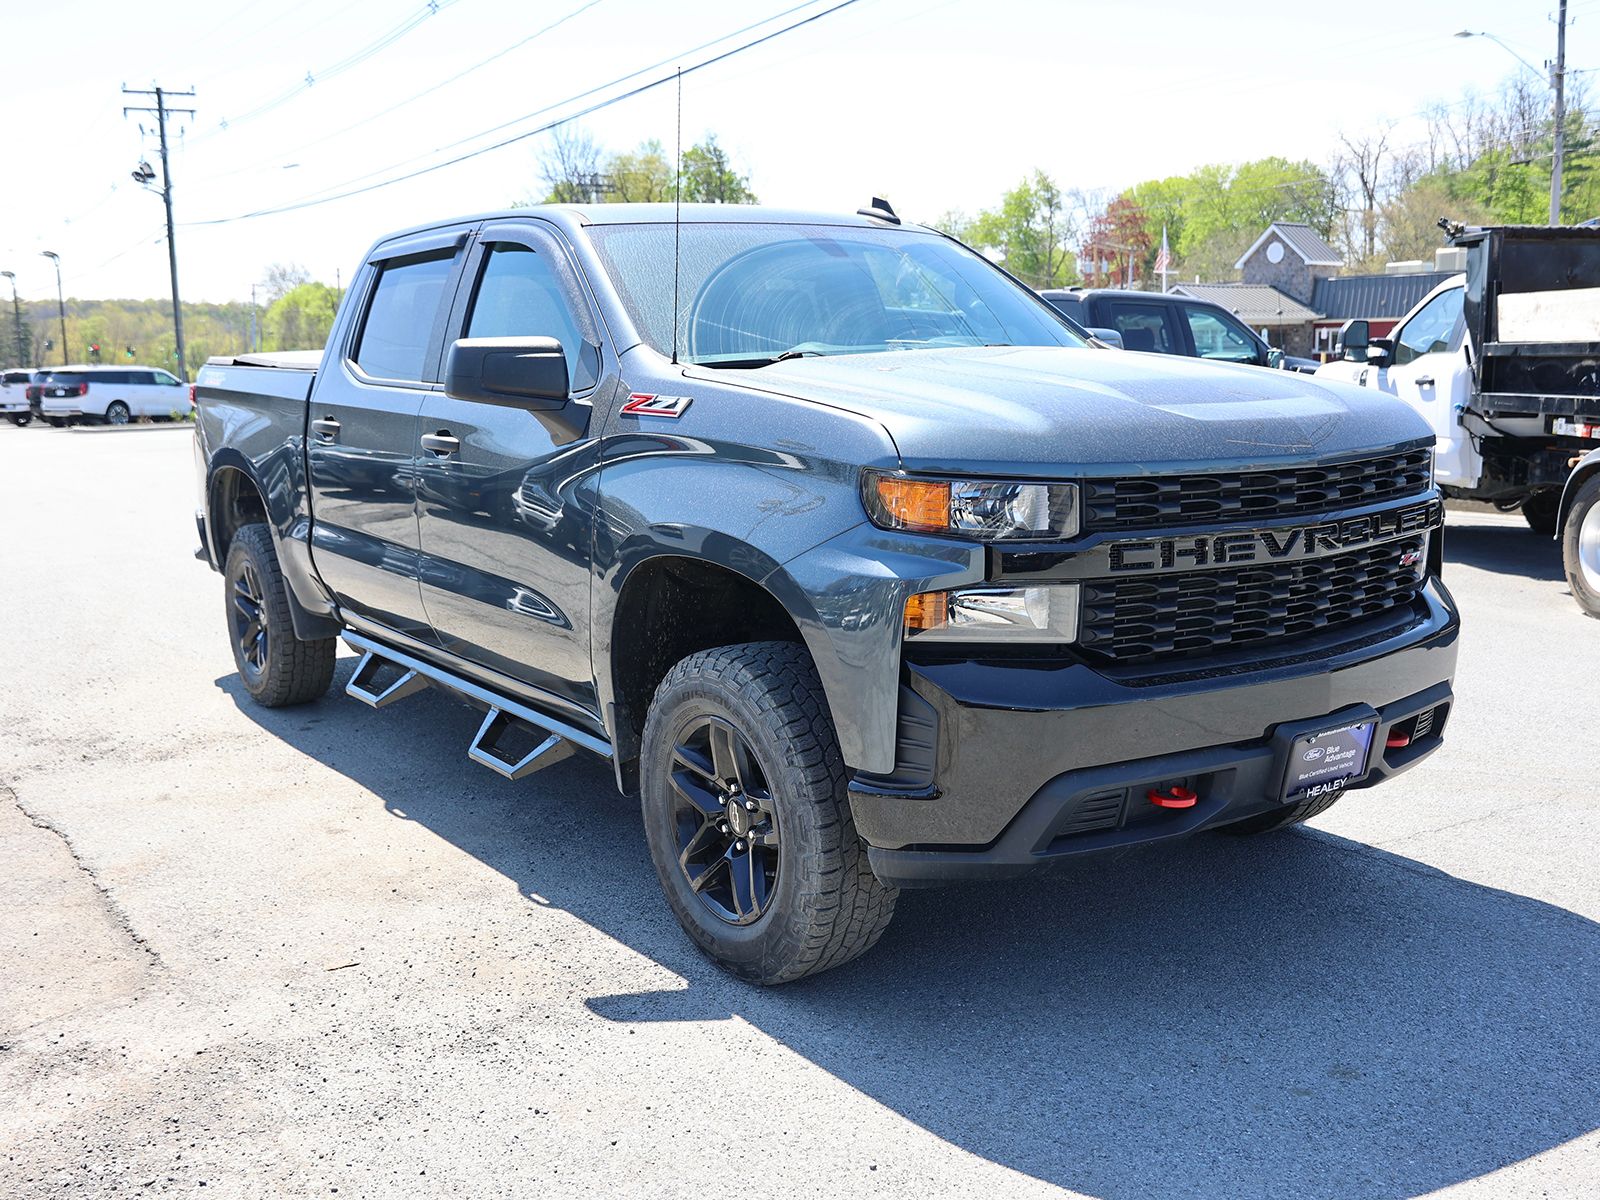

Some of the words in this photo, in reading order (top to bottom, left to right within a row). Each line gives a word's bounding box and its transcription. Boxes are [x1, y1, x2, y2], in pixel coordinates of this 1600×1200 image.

[619, 392, 694, 418] Z71
[1305, 748, 1323, 760] Ford
[1326, 745, 1340, 755] Blue
[1324, 750, 1356, 763] Advantage
[1309, 768, 1327, 777] Certified
[1306, 777, 1348, 798] HEALEY
